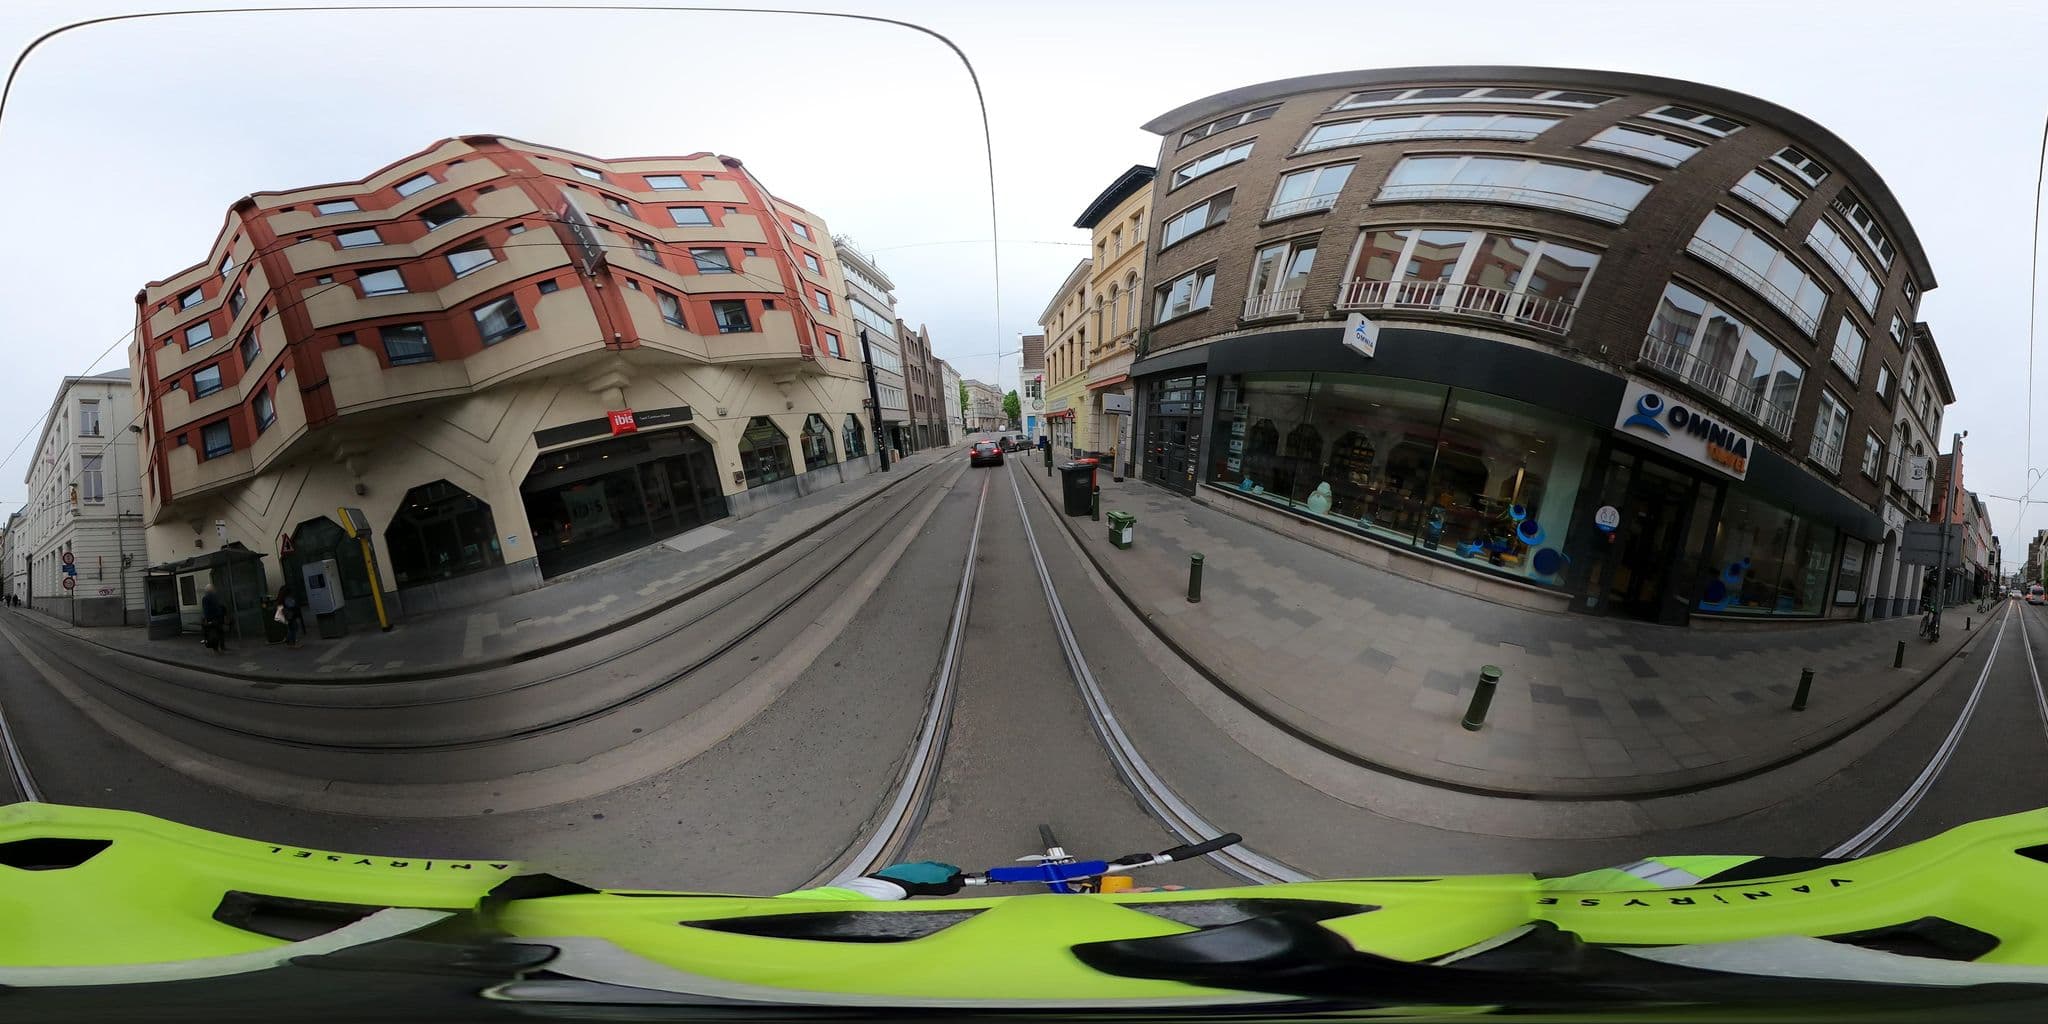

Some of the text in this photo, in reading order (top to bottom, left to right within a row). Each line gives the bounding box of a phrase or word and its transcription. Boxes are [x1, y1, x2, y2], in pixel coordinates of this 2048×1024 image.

[568, 215, 596, 258] HOTEL
[614, 414, 634, 426] ibis
[1668, 405, 1748, 459] OMNIA
